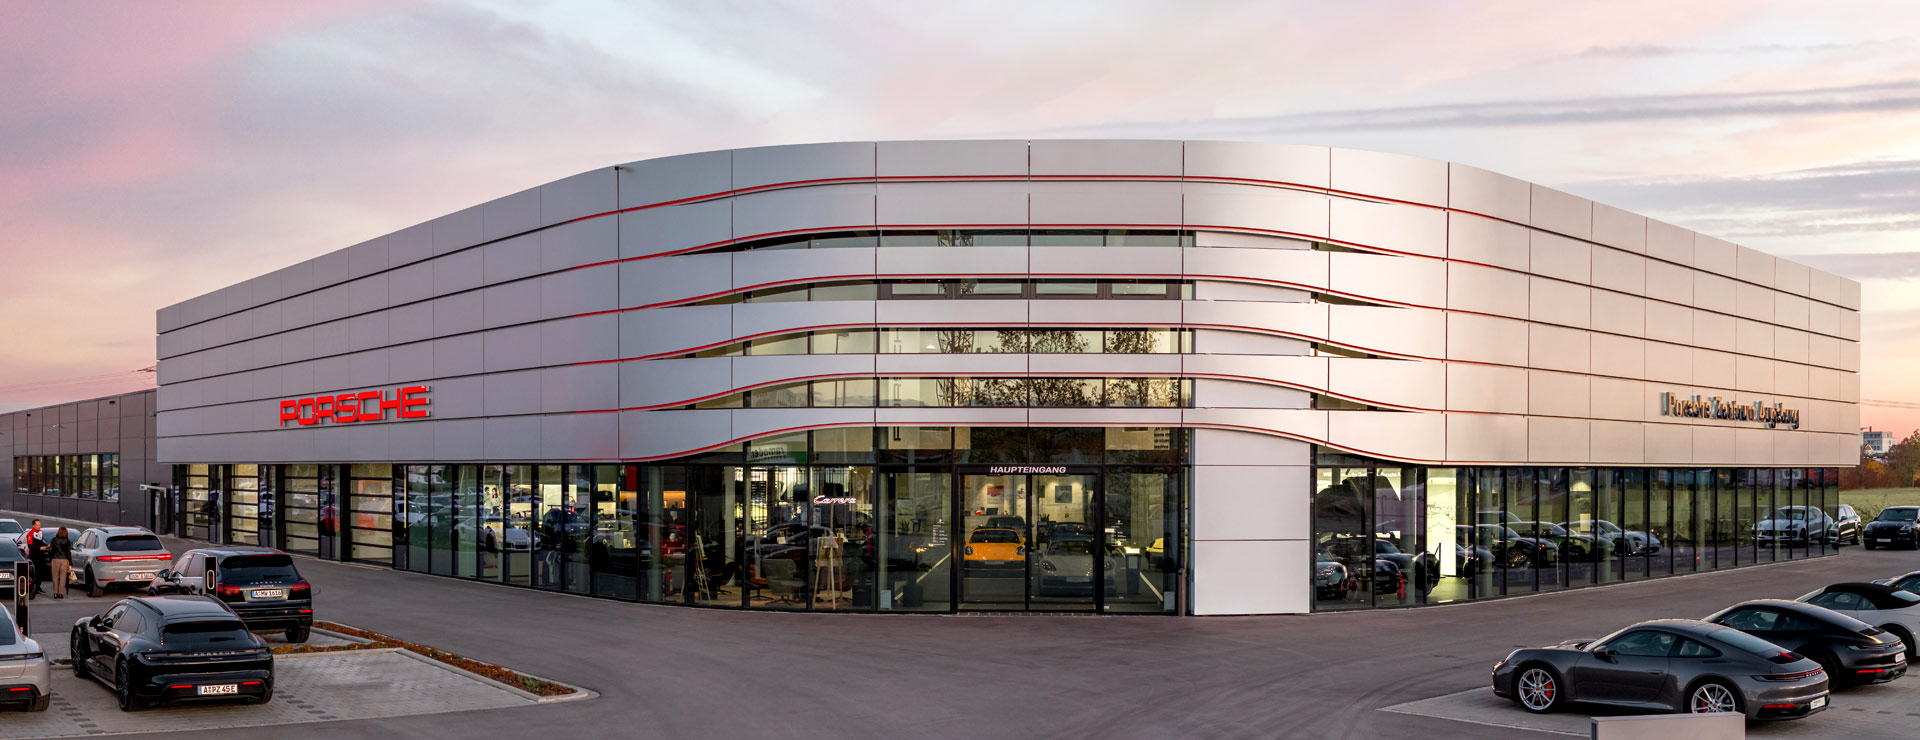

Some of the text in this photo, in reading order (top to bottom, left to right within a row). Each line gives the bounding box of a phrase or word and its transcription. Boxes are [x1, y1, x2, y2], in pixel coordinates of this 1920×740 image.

[280, 385, 431, 427] PORSCHE
[1662, 392, 1800, 430] Porsche Zentrum Augsburg
[990, 466, 1067, 474] HAUPTEINGANG
[813, 494, 856, 504] Carrera
